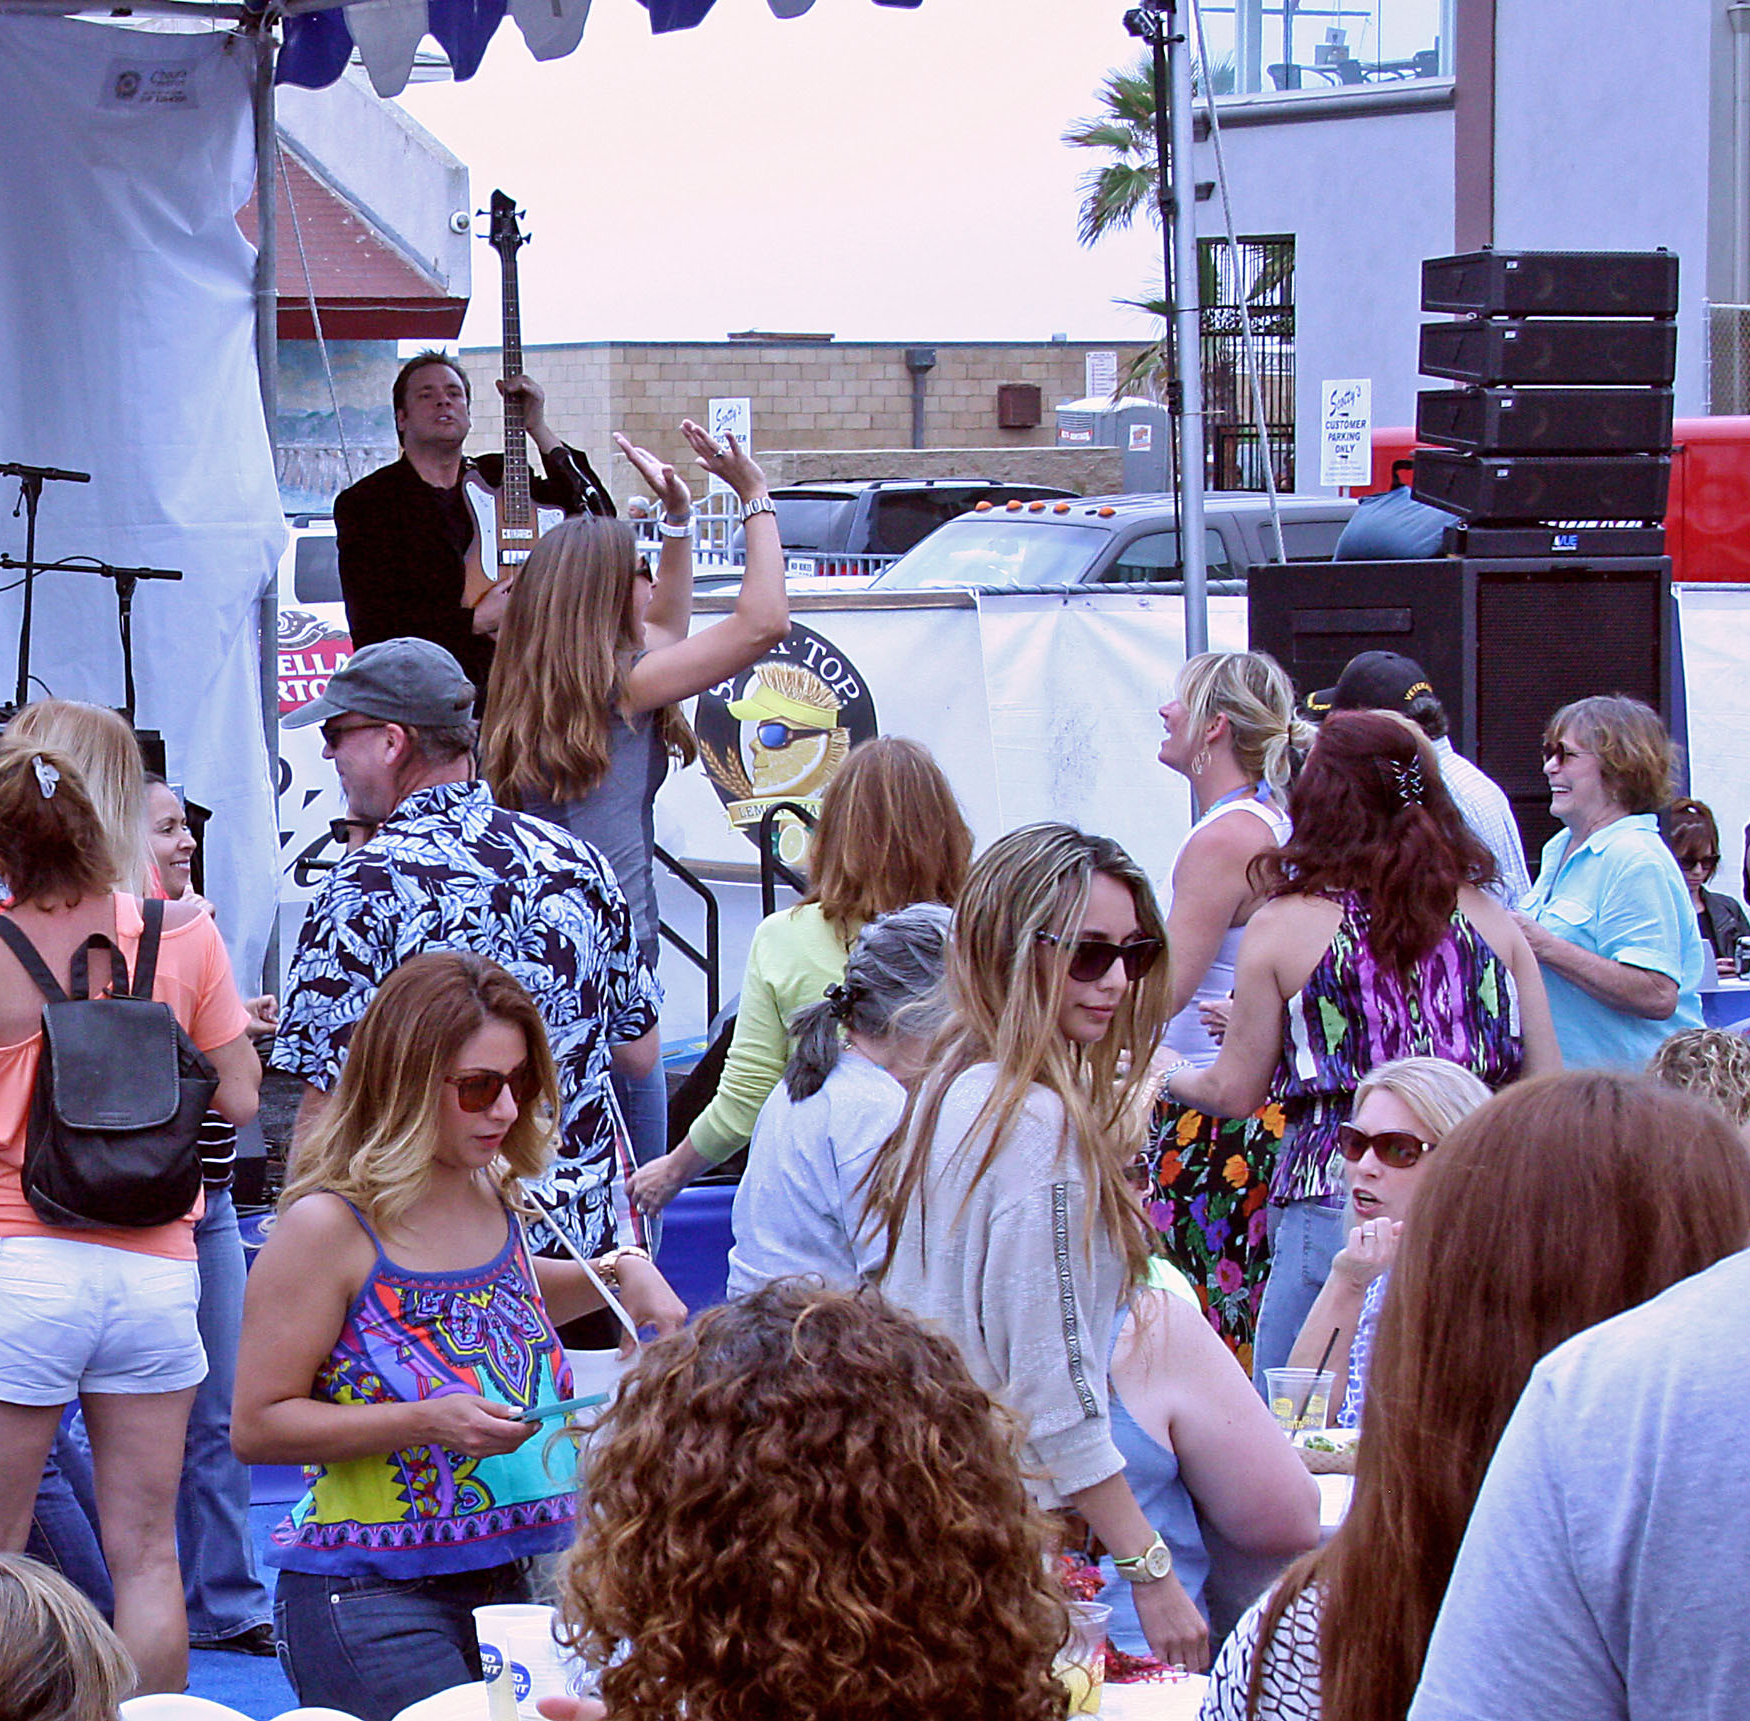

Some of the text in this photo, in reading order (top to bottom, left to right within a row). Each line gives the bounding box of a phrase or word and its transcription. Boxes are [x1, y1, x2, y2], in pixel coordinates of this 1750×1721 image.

[1325, 419, 1367, 430] CUSTOMER
[1328, 432, 1361, 442] PARKING
[1335, 444, 1356, 454] ONLY
[277, 652, 351, 677] ELLA
[277, 678, 328, 702] RTO
